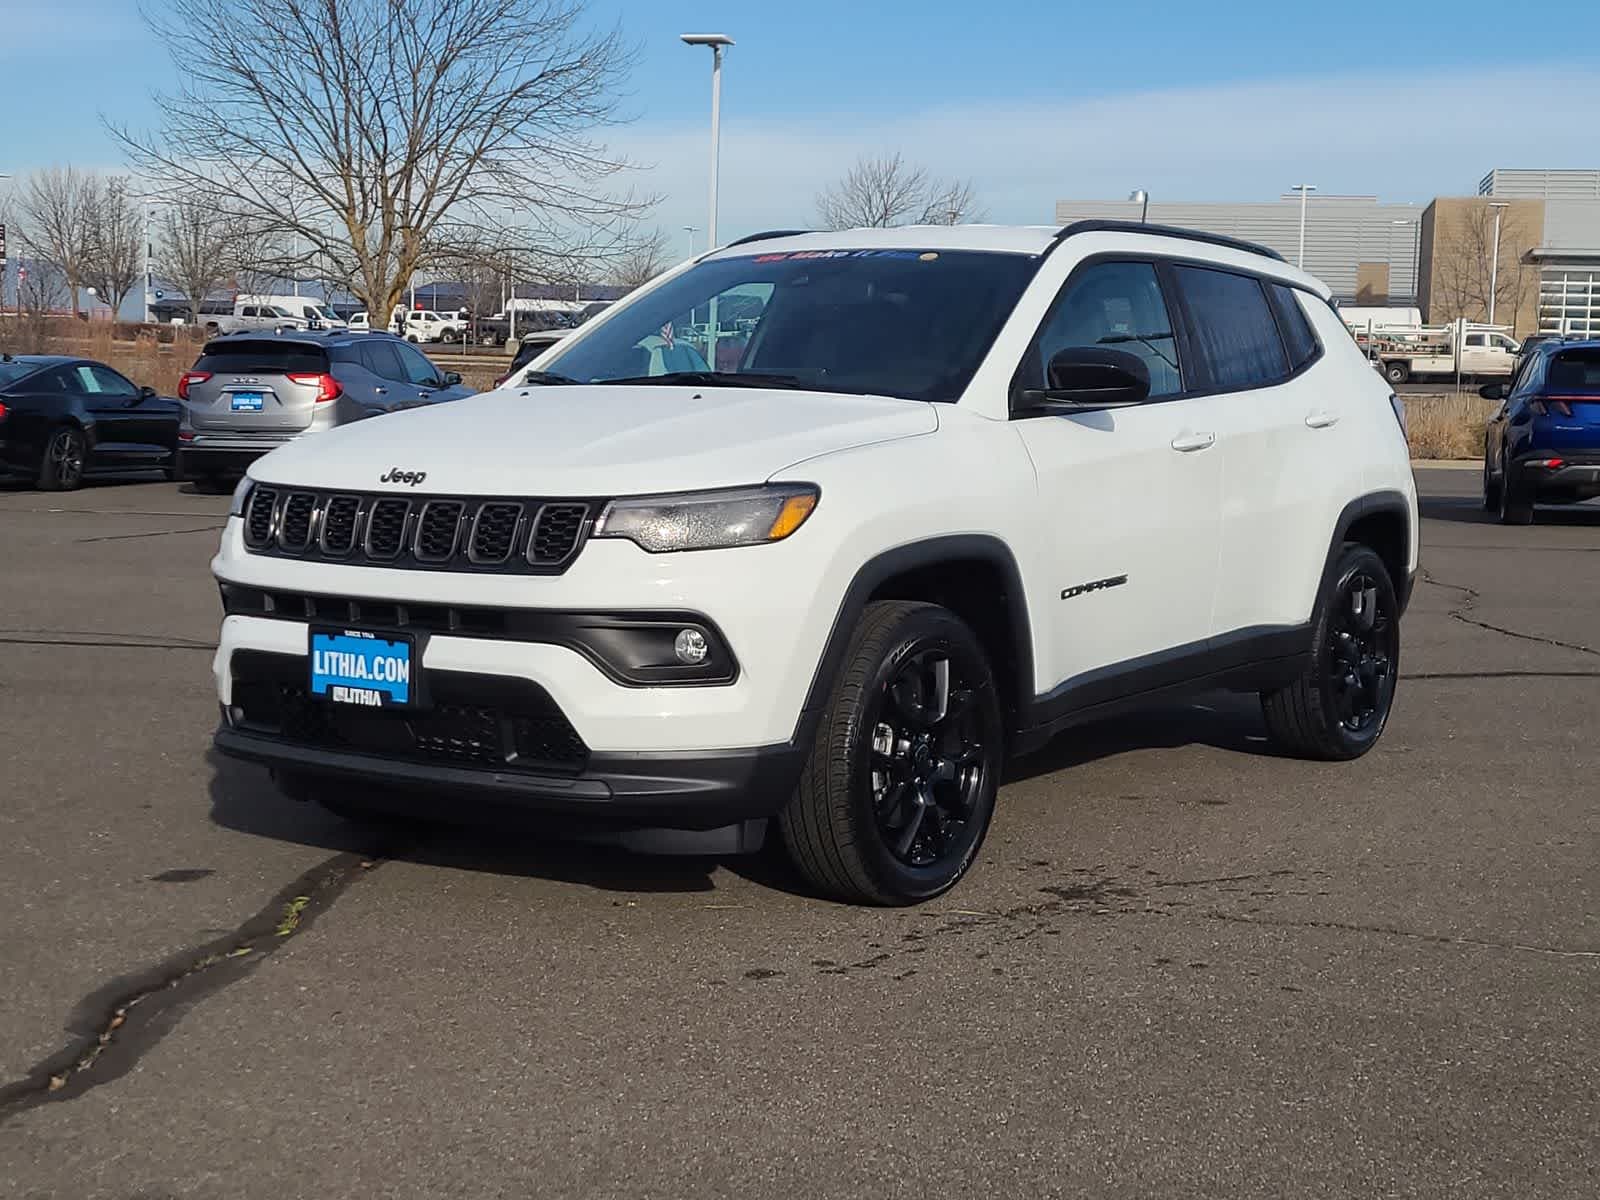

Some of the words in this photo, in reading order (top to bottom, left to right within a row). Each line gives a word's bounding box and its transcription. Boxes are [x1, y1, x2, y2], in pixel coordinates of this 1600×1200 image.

[380, 467, 427, 487] Jeep
[313, 650, 409, 684] LITHIA.COM
[345, 687, 383, 707] LITHIA
